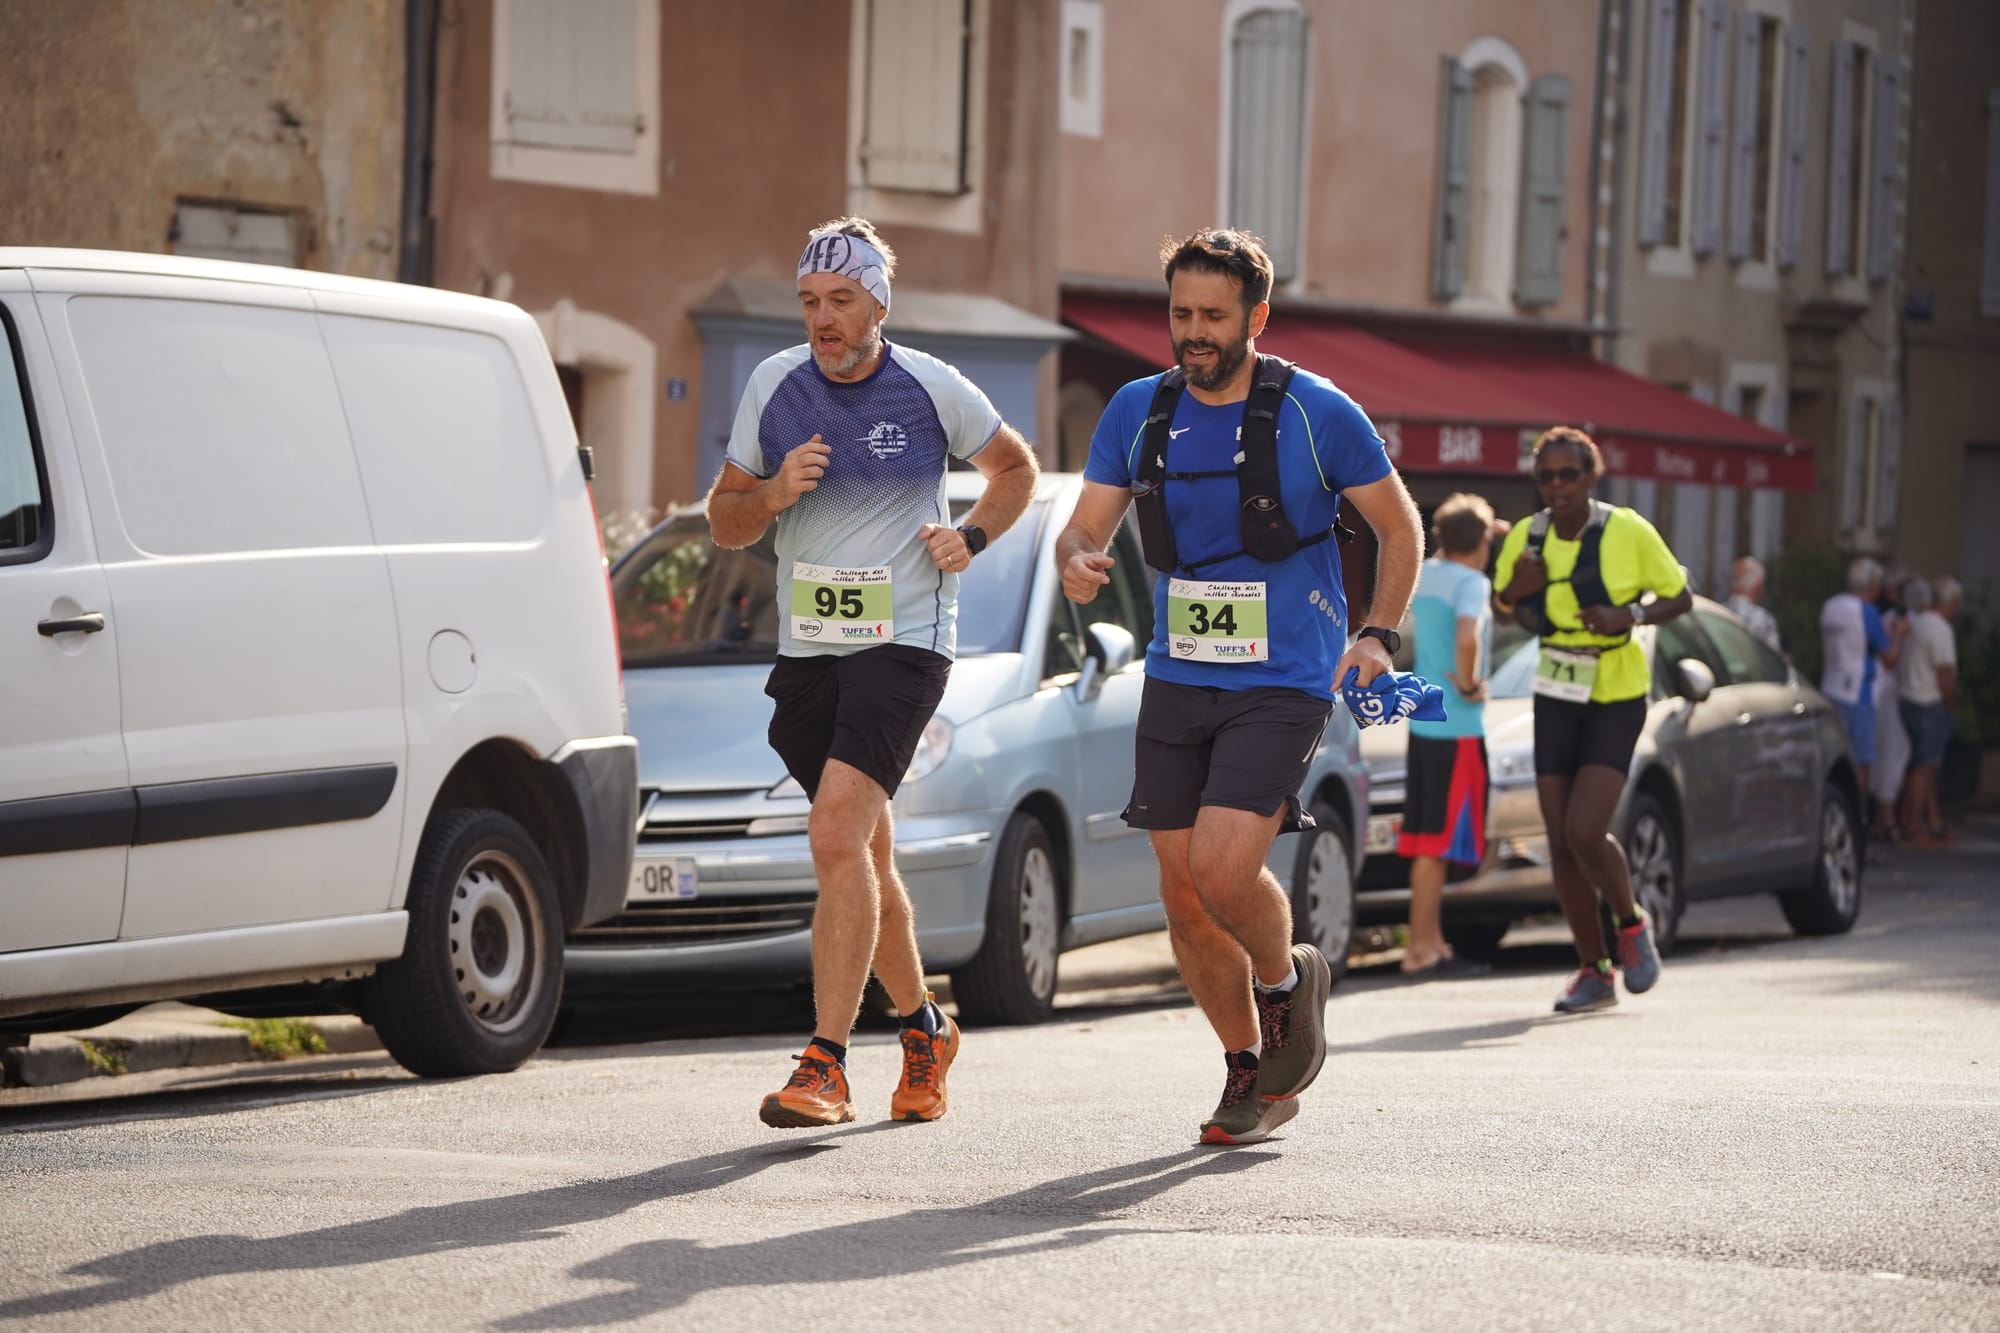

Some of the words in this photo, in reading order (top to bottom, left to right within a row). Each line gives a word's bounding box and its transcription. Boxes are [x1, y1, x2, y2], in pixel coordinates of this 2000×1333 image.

[1438, 426, 1484, 464] BAR
[835, 569, 869, 578] Challenge
[1207, 584, 1241, 593] Challenge
[814, 586, 864, 619] 95
[1188, 603, 1238, 636] 34
[799, 623, 820, 632] BFP
[1176, 642, 1194, 650] BFP
[1214, 645, 1246, 653] TUFF'S
[1550, 660, 1575, 682] 71
